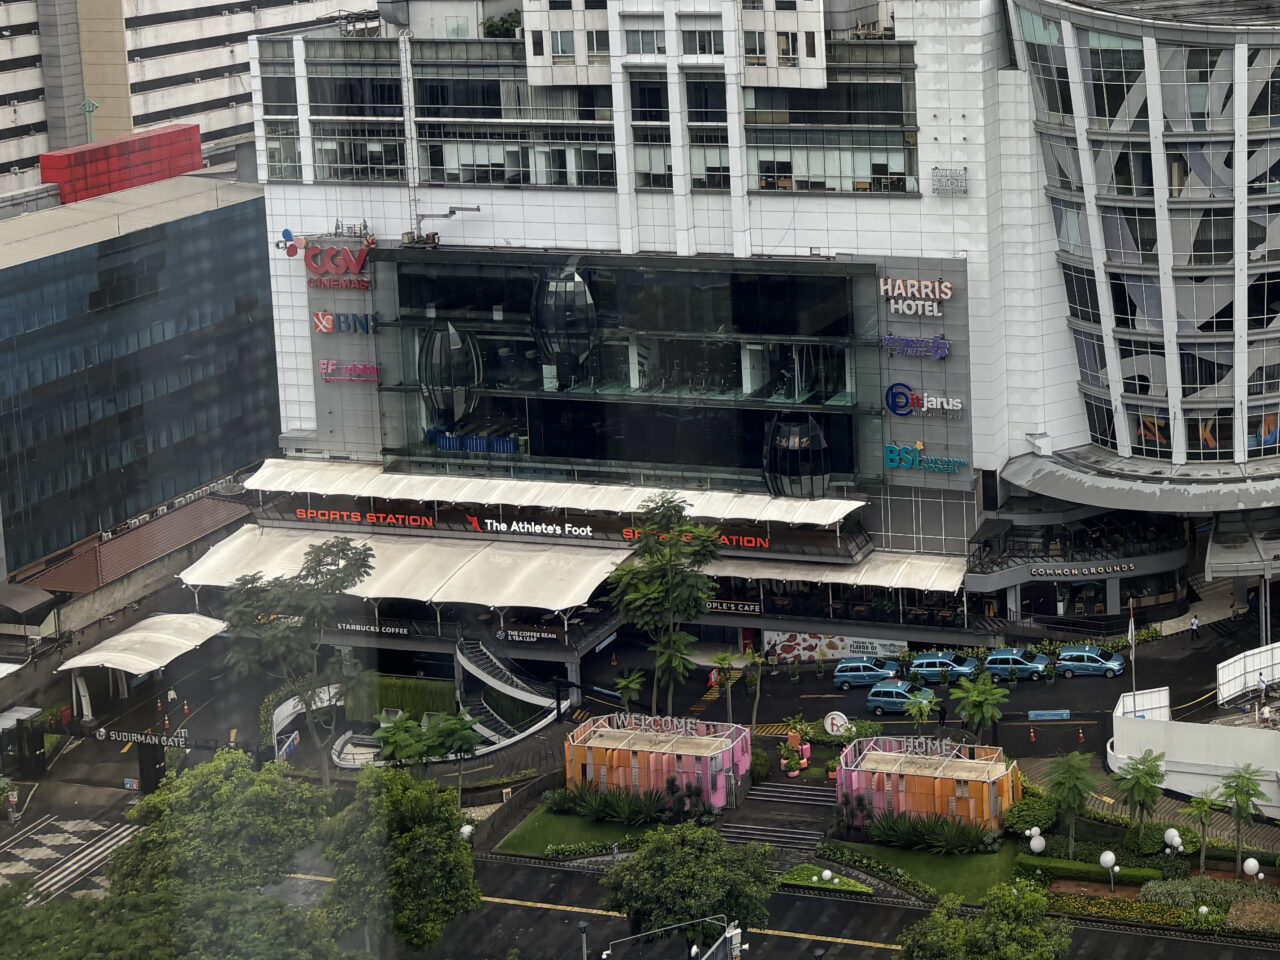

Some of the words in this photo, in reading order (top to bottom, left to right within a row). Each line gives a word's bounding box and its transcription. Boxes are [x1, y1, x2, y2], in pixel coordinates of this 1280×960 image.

[304, 246, 368, 275] CGV
[307, 277, 370, 290] CINEMAS
[880, 278, 953, 299] HARRIS
[890, 299, 943, 317] HOTEL
[884, 444, 919, 471] BSI
[296, 509, 362, 522] SPORTS
[366, 513, 433, 527] STATION
[485, 519, 507, 531] The
[510, 521, 562, 534] Athlete's
[565, 524, 593, 536] Foot
[1082, 563, 1135, 575] GROUNDS
[738, 604, 760, 612] CAFE
[337, 623, 380, 632] STARBUCKS
[381, 626, 408, 634] COFFEE
[614, 712, 697, 735] WELCOME
[109, 731, 159, 744] SUDIRMAN
[160, 736, 186, 748] GATE
[903, 737, 953, 756] HOME
